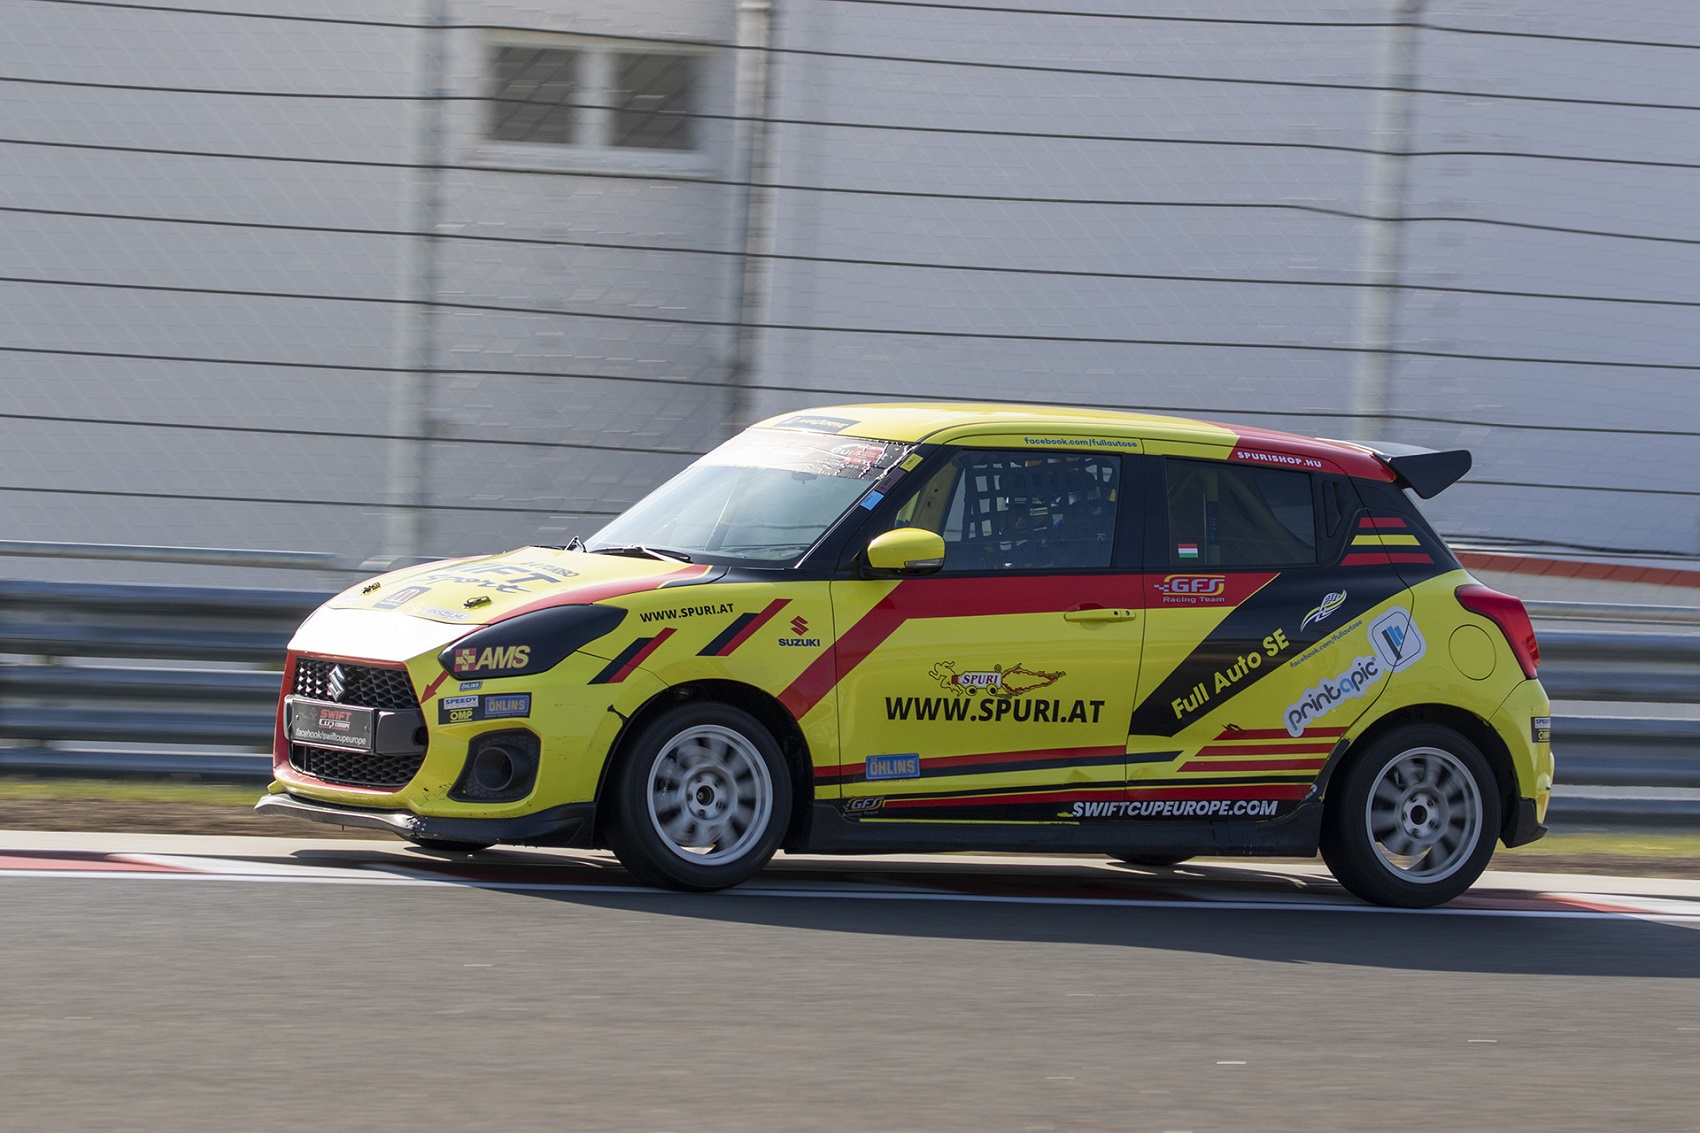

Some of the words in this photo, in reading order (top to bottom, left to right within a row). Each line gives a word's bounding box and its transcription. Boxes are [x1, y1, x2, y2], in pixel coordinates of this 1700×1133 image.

[1024, 436, 1138, 449] facebook.com/fullautose
[1236, 451, 1322, 468] SPURISHOP.HU
[1171, 578, 1225, 592] GFS
[1162, 596, 1197, 604] Racing
[639, 603, 734, 622] WWW.SPURI.AT
[778, 638, 821, 647] SUZUKI
[1289, 619, 1363, 669] facebook.com/fullautose
[474, 645, 531, 670] AMS
[962, 672, 999, 686] SPURI
[1171, 682, 1210, 720] Full
[1212, 653, 1262, 695] Auto
[1262, 628, 1290, 657] SE
[445, 696, 477, 705] SPEEDY
[488, 698, 526, 712] ÖHLINS
[320, 708, 352, 721] SWIFT
[449, 709, 473, 720] OMP
[885, 697, 1105, 723] WWW.SPURI.AT
[869, 758, 916, 775] ÖHLINS
[1072, 800, 1279, 818] SWIFTCUPEUROPE.COM
